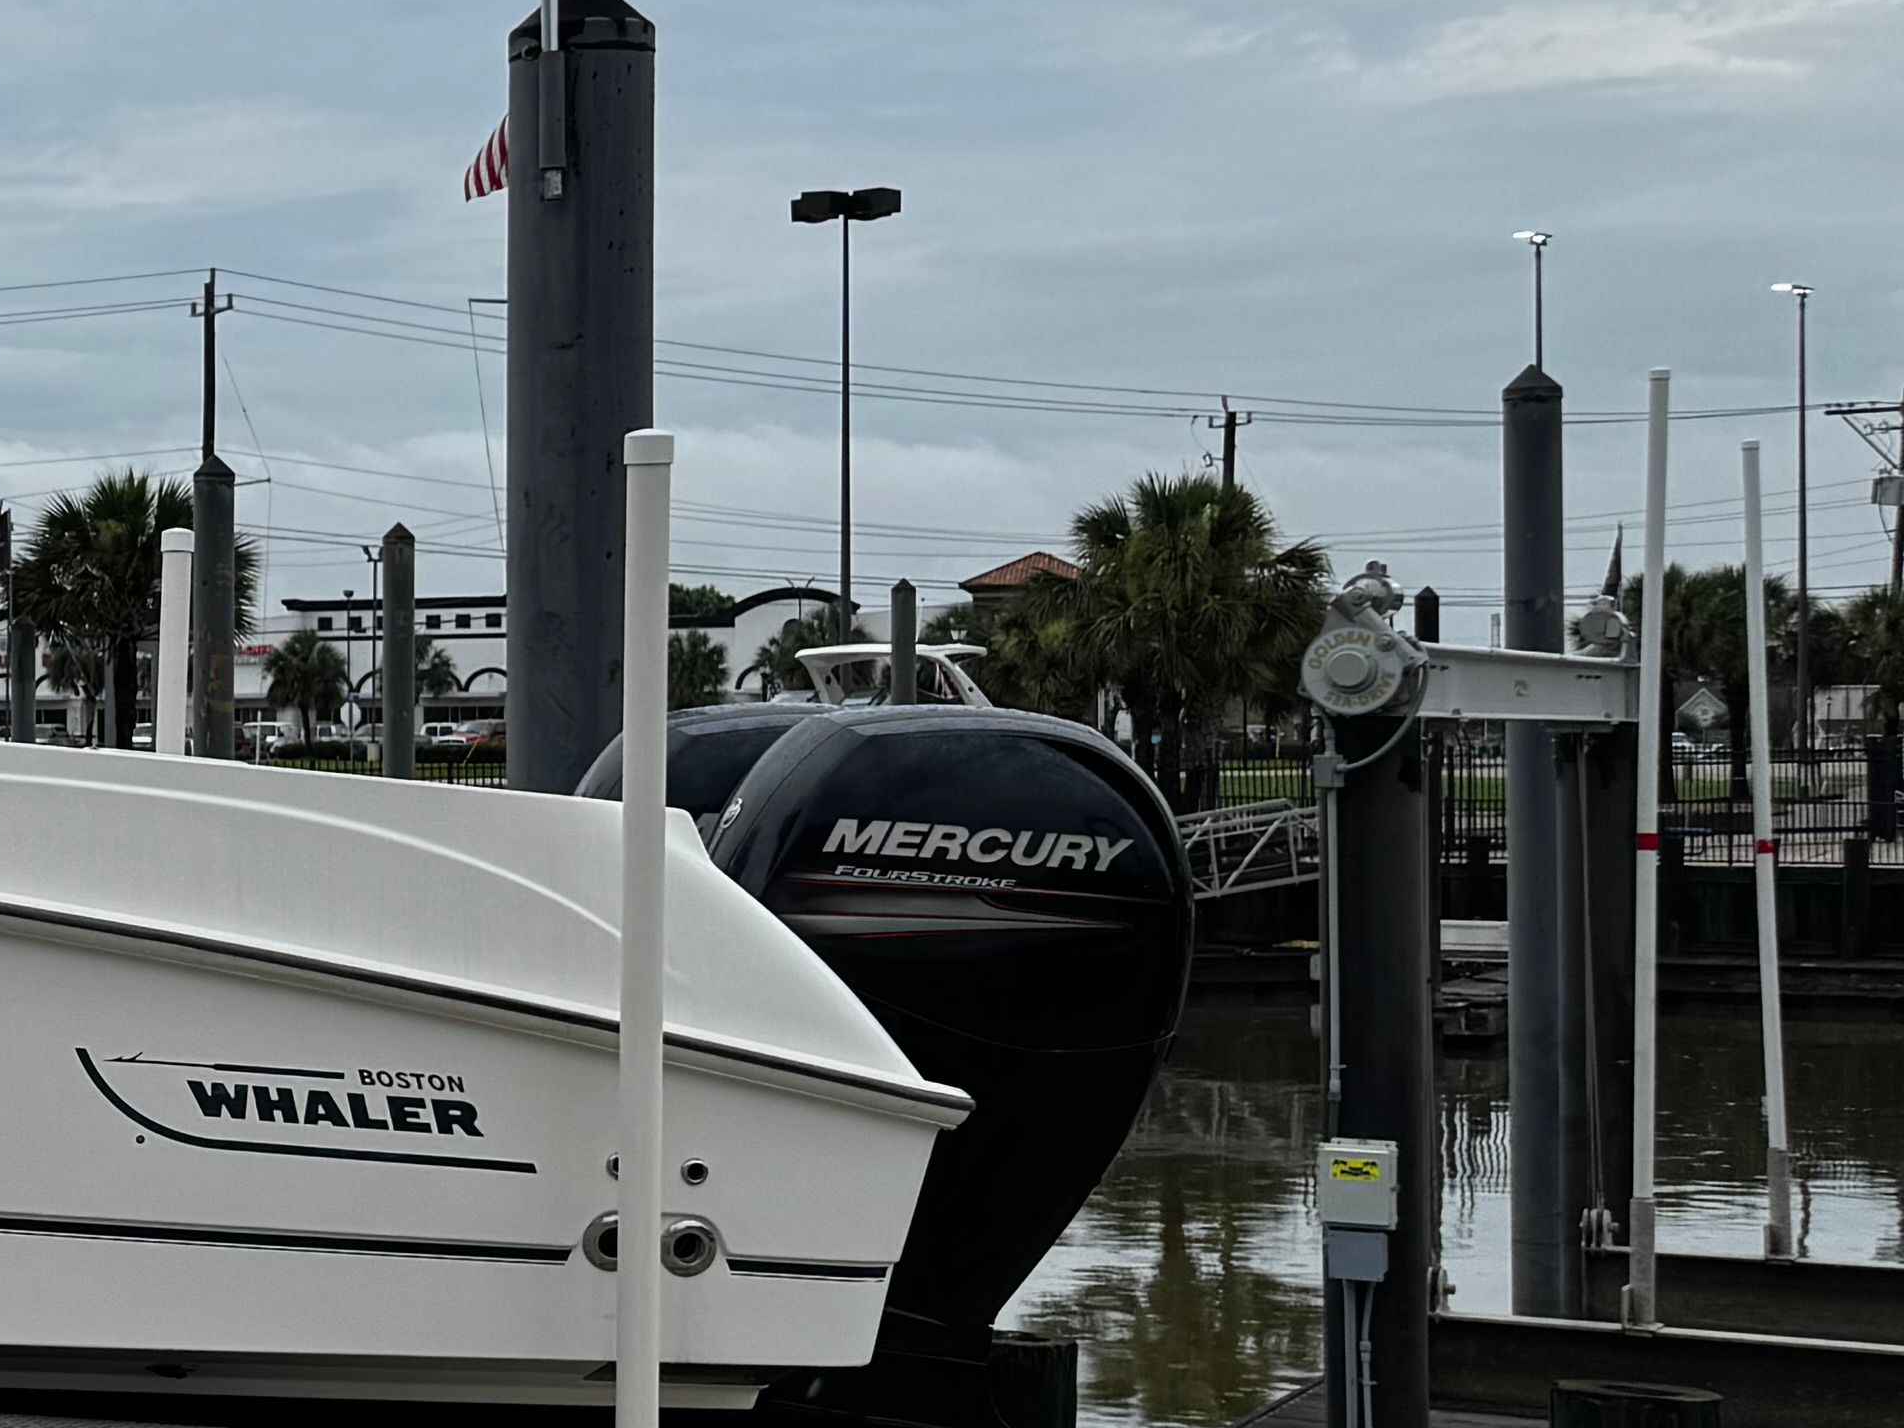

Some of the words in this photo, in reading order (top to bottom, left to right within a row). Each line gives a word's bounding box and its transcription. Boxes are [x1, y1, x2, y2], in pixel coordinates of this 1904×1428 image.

[822, 818, 1134, 872] MERCURY
[186, 1079, 485, 1138] WHALER
[358, 1069, 466, 1094] BOSTON
